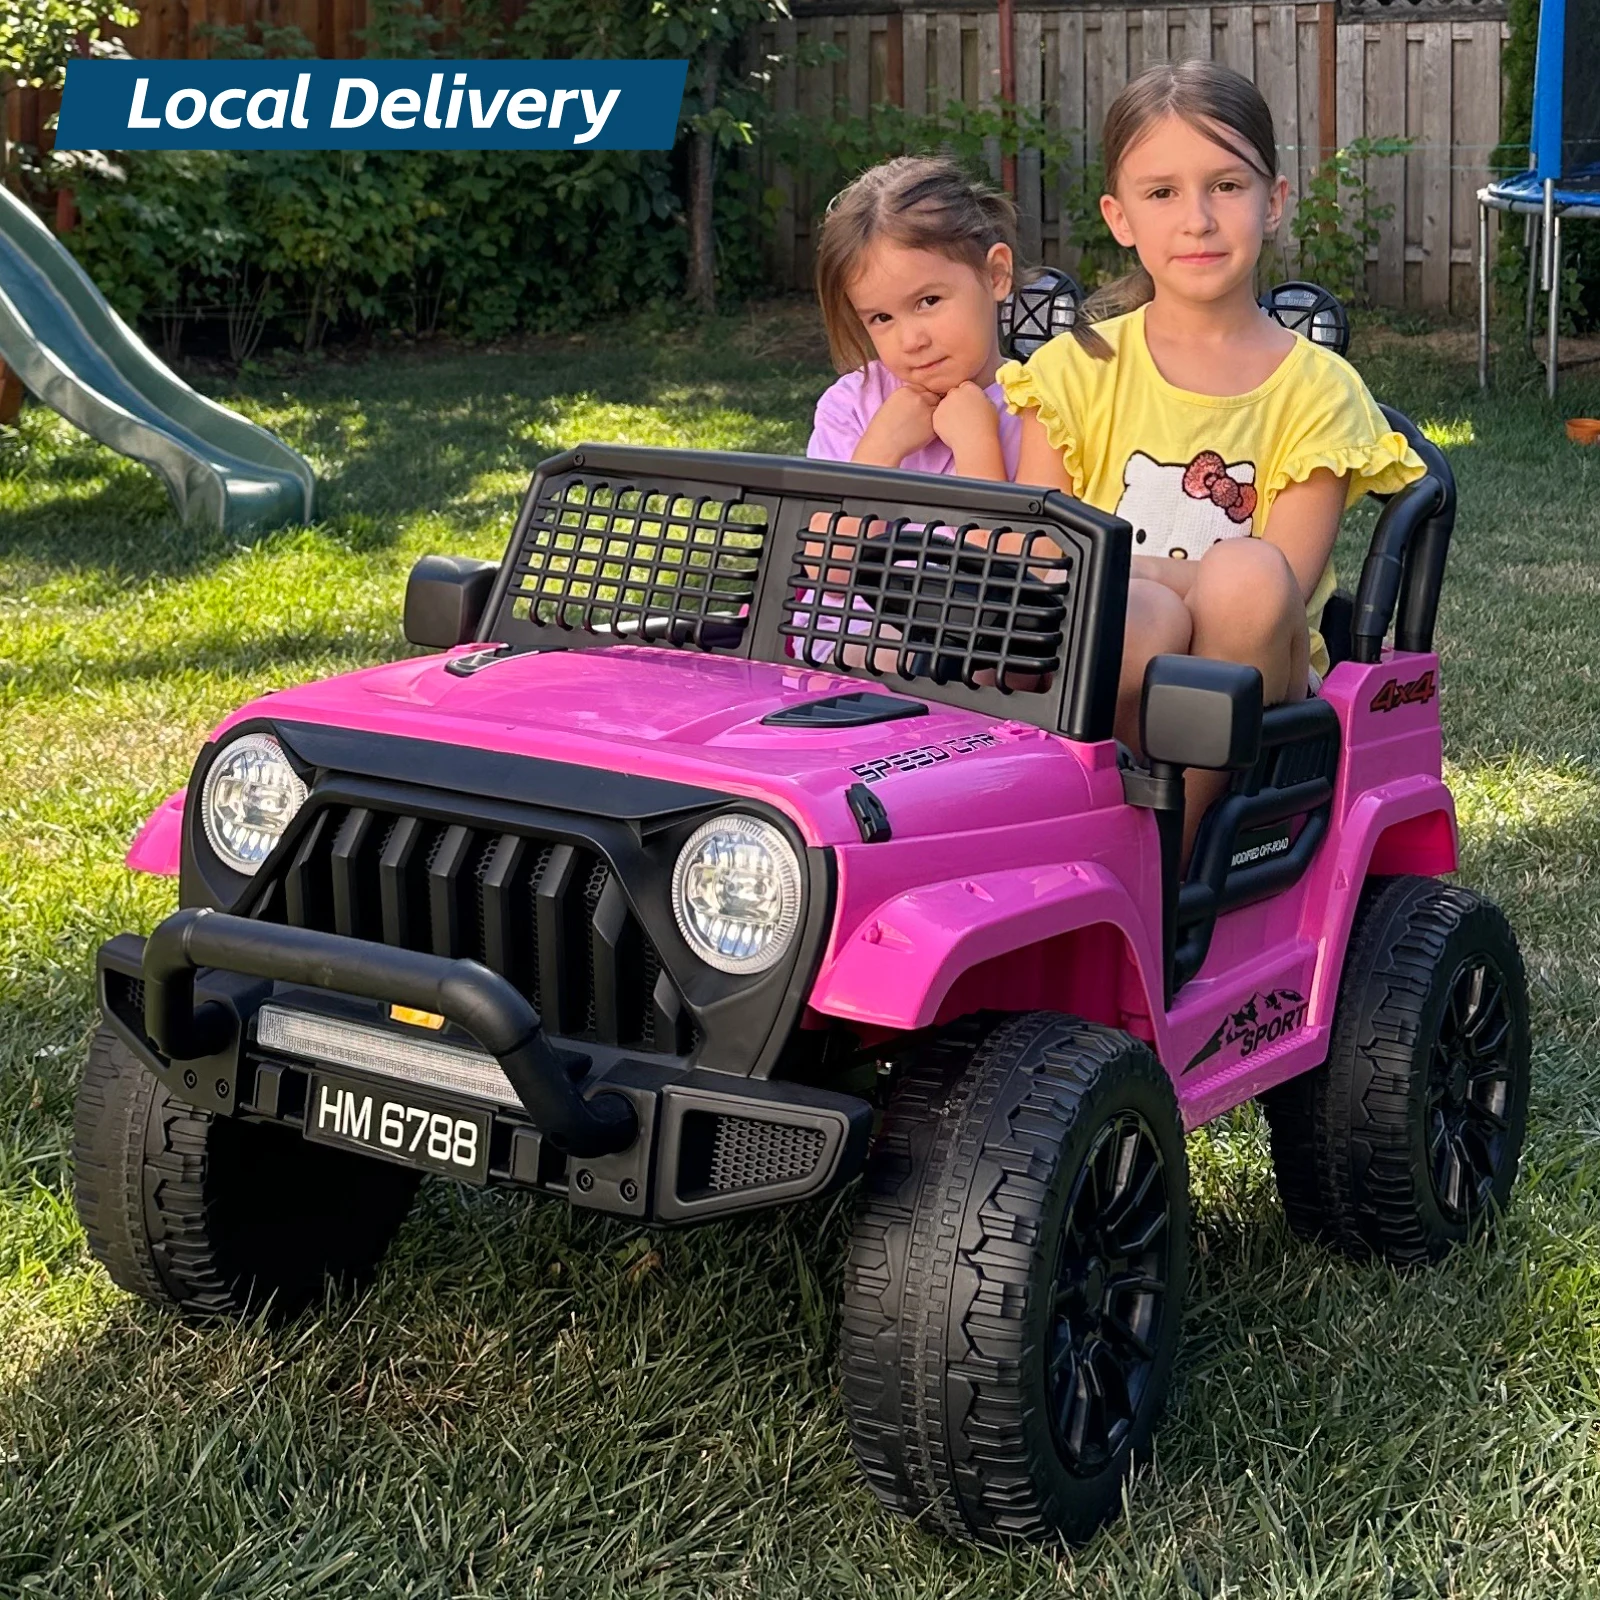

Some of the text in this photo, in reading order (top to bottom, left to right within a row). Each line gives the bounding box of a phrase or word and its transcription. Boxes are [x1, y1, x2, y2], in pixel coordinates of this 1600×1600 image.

[1369, 669, 1436, 713] 4x4
[849, 732, 1003, 784] SPEED CAR
[1240, 1002, 1310, 1057] SPORT
[318, 1085, 478, 1167] HM 6788
